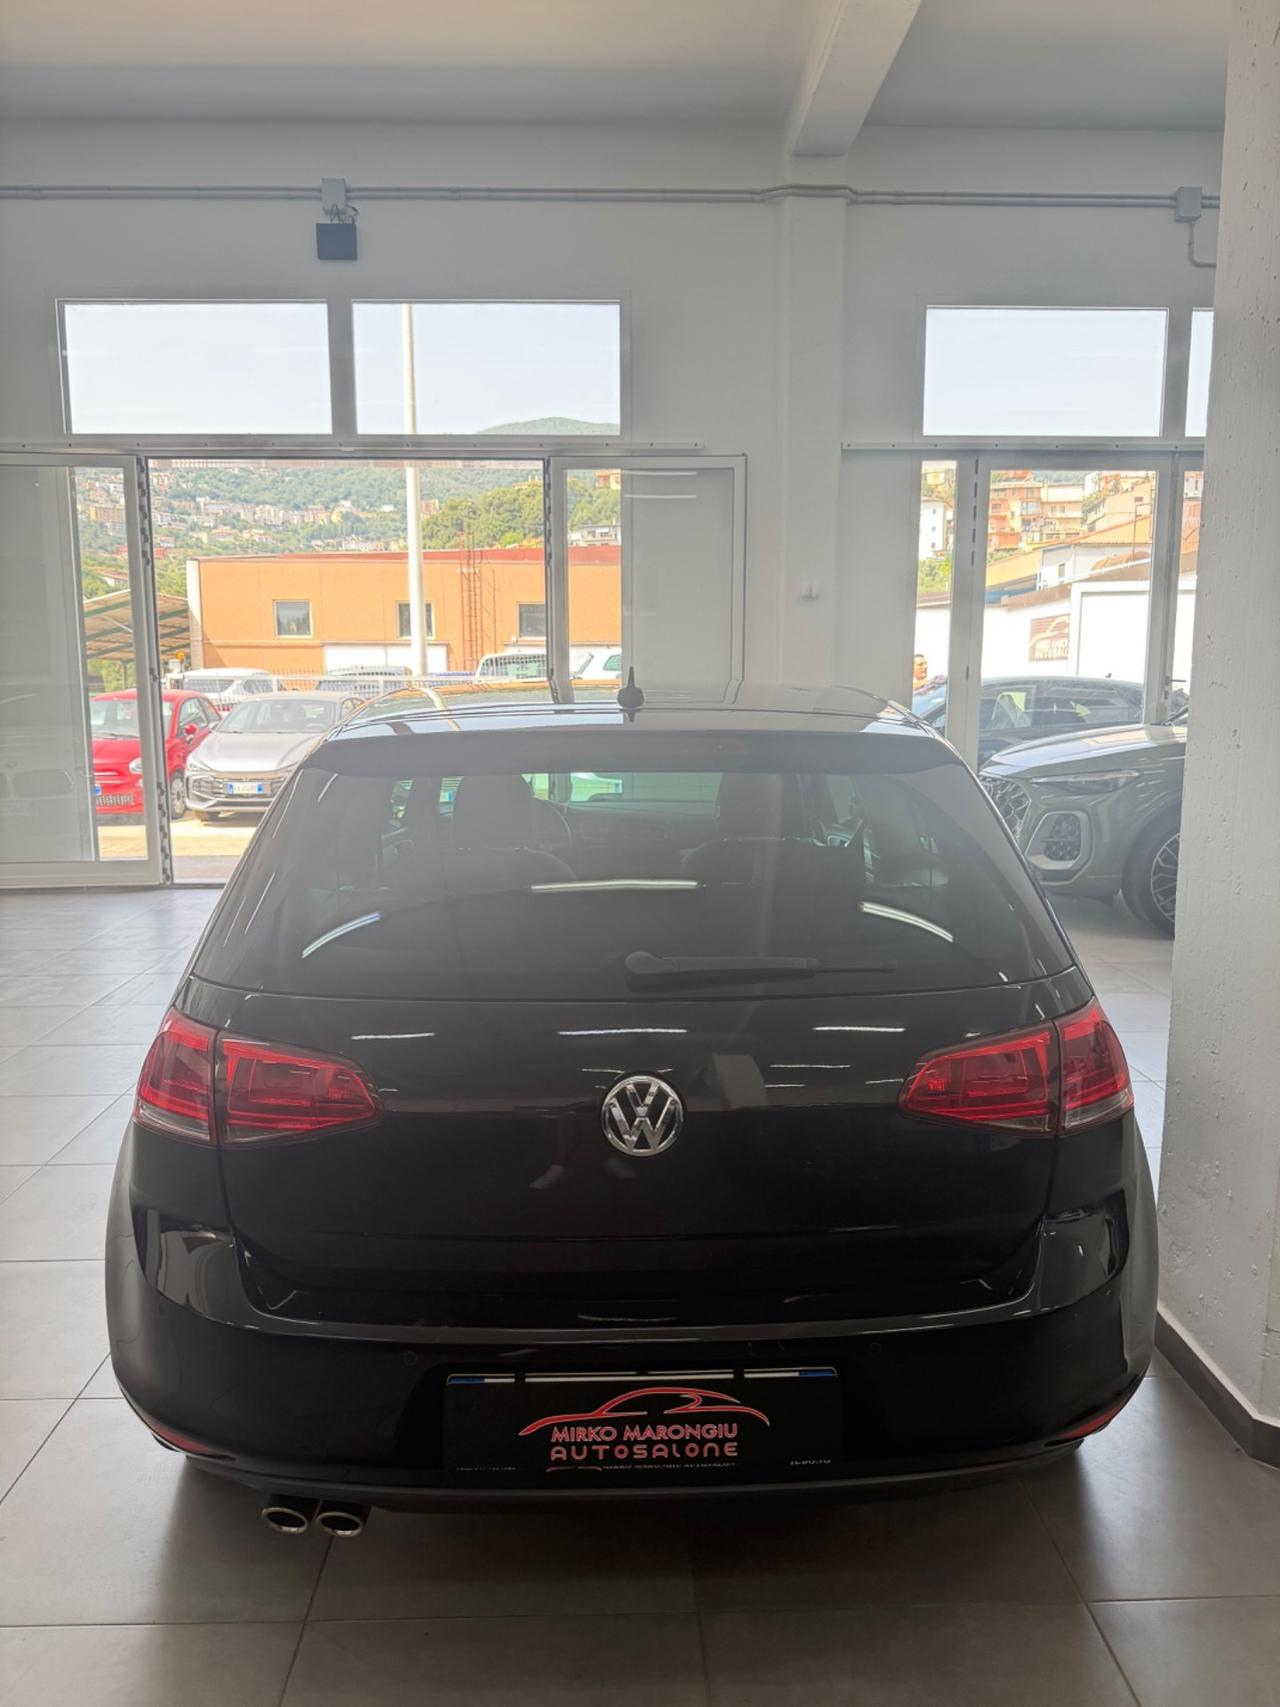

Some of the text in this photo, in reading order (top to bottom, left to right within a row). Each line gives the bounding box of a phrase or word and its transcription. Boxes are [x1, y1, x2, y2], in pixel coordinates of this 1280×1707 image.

[550, 1422, 739, 1442] MIRKO MARONGIU
[550, 1441, 739, 1461] AUTOSALONE
